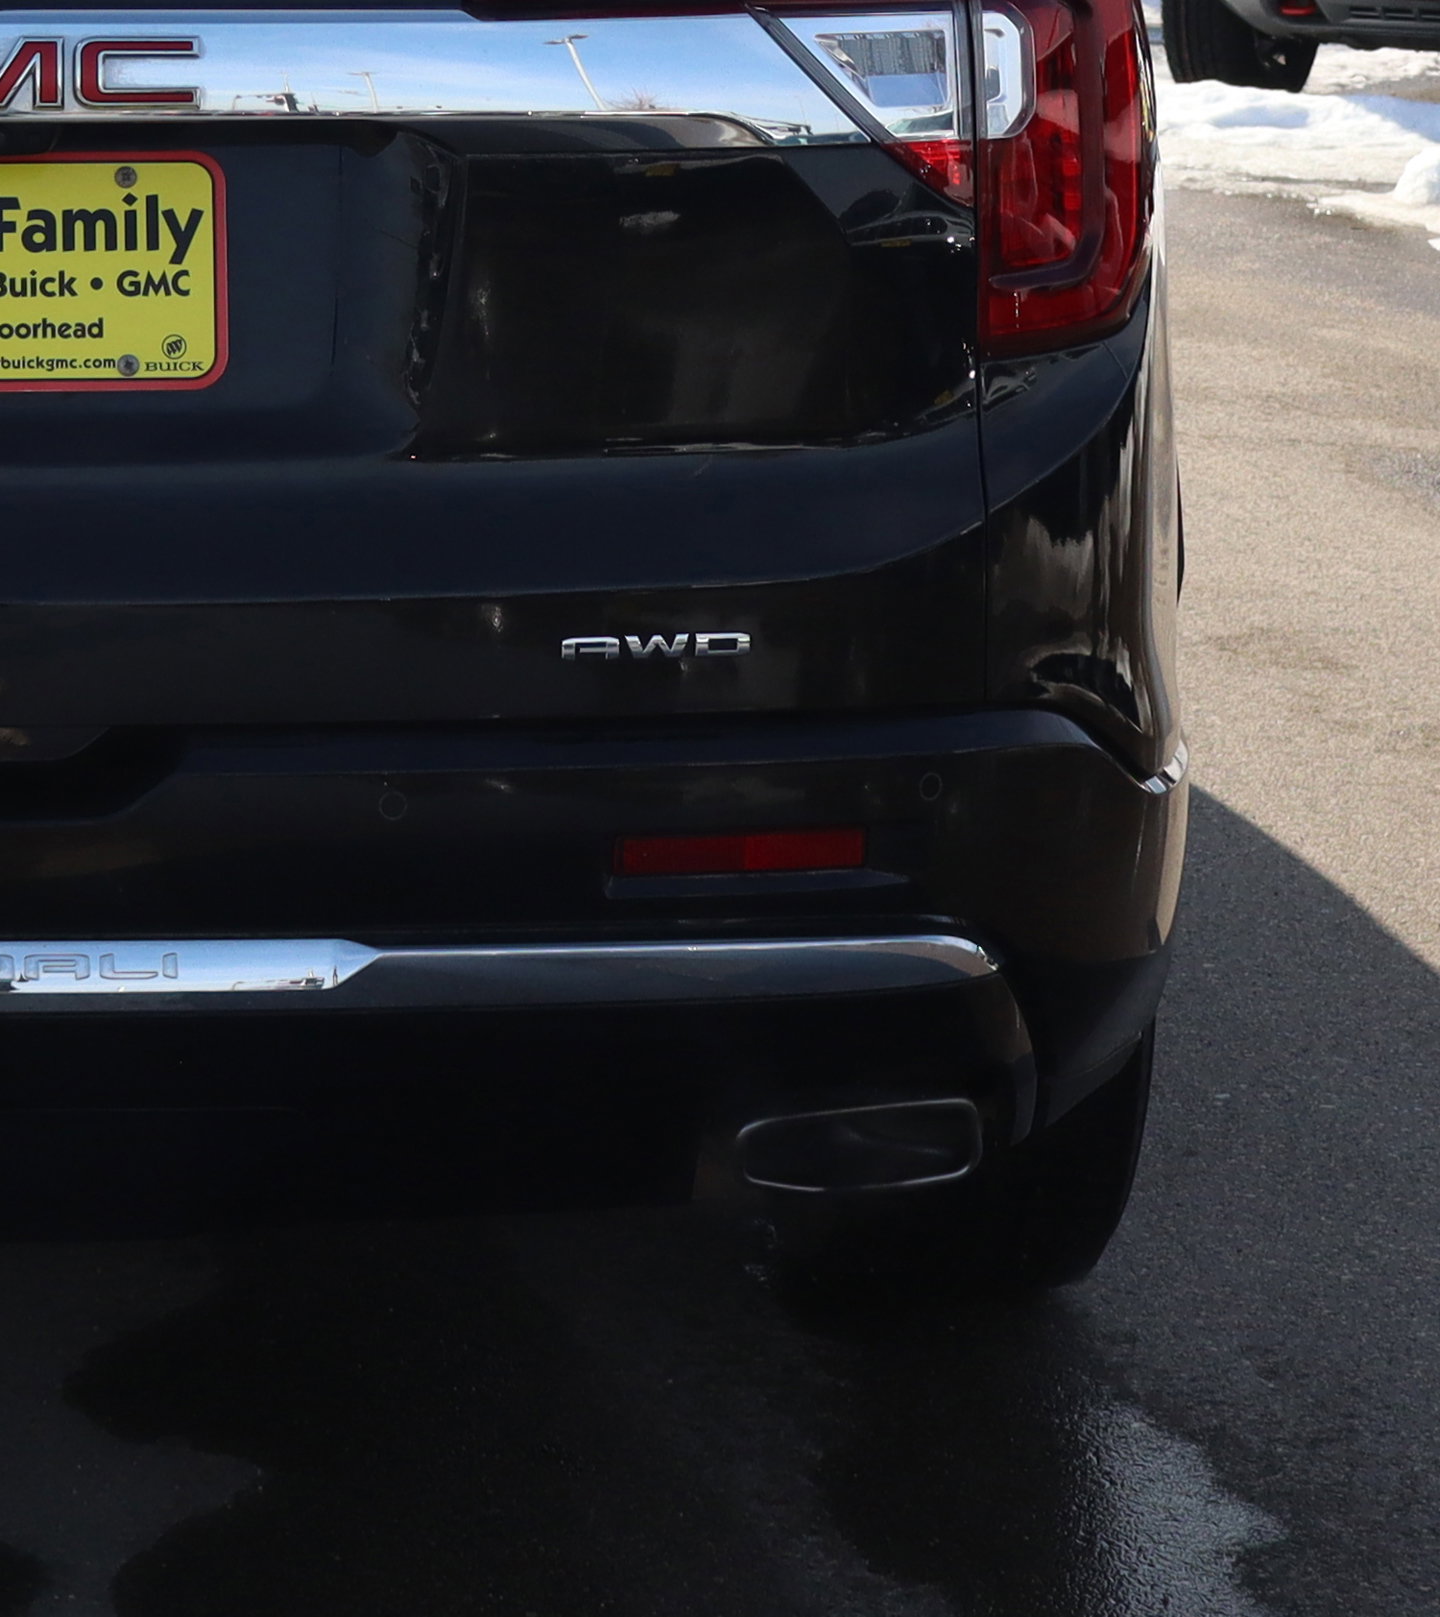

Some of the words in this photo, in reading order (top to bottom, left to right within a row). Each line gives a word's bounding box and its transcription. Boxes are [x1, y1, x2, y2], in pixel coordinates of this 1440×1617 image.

[116, 269, 191, 297] GMC
[144, 361, 204, 371] BUICK
[561, 632, 752, 661] AWD
